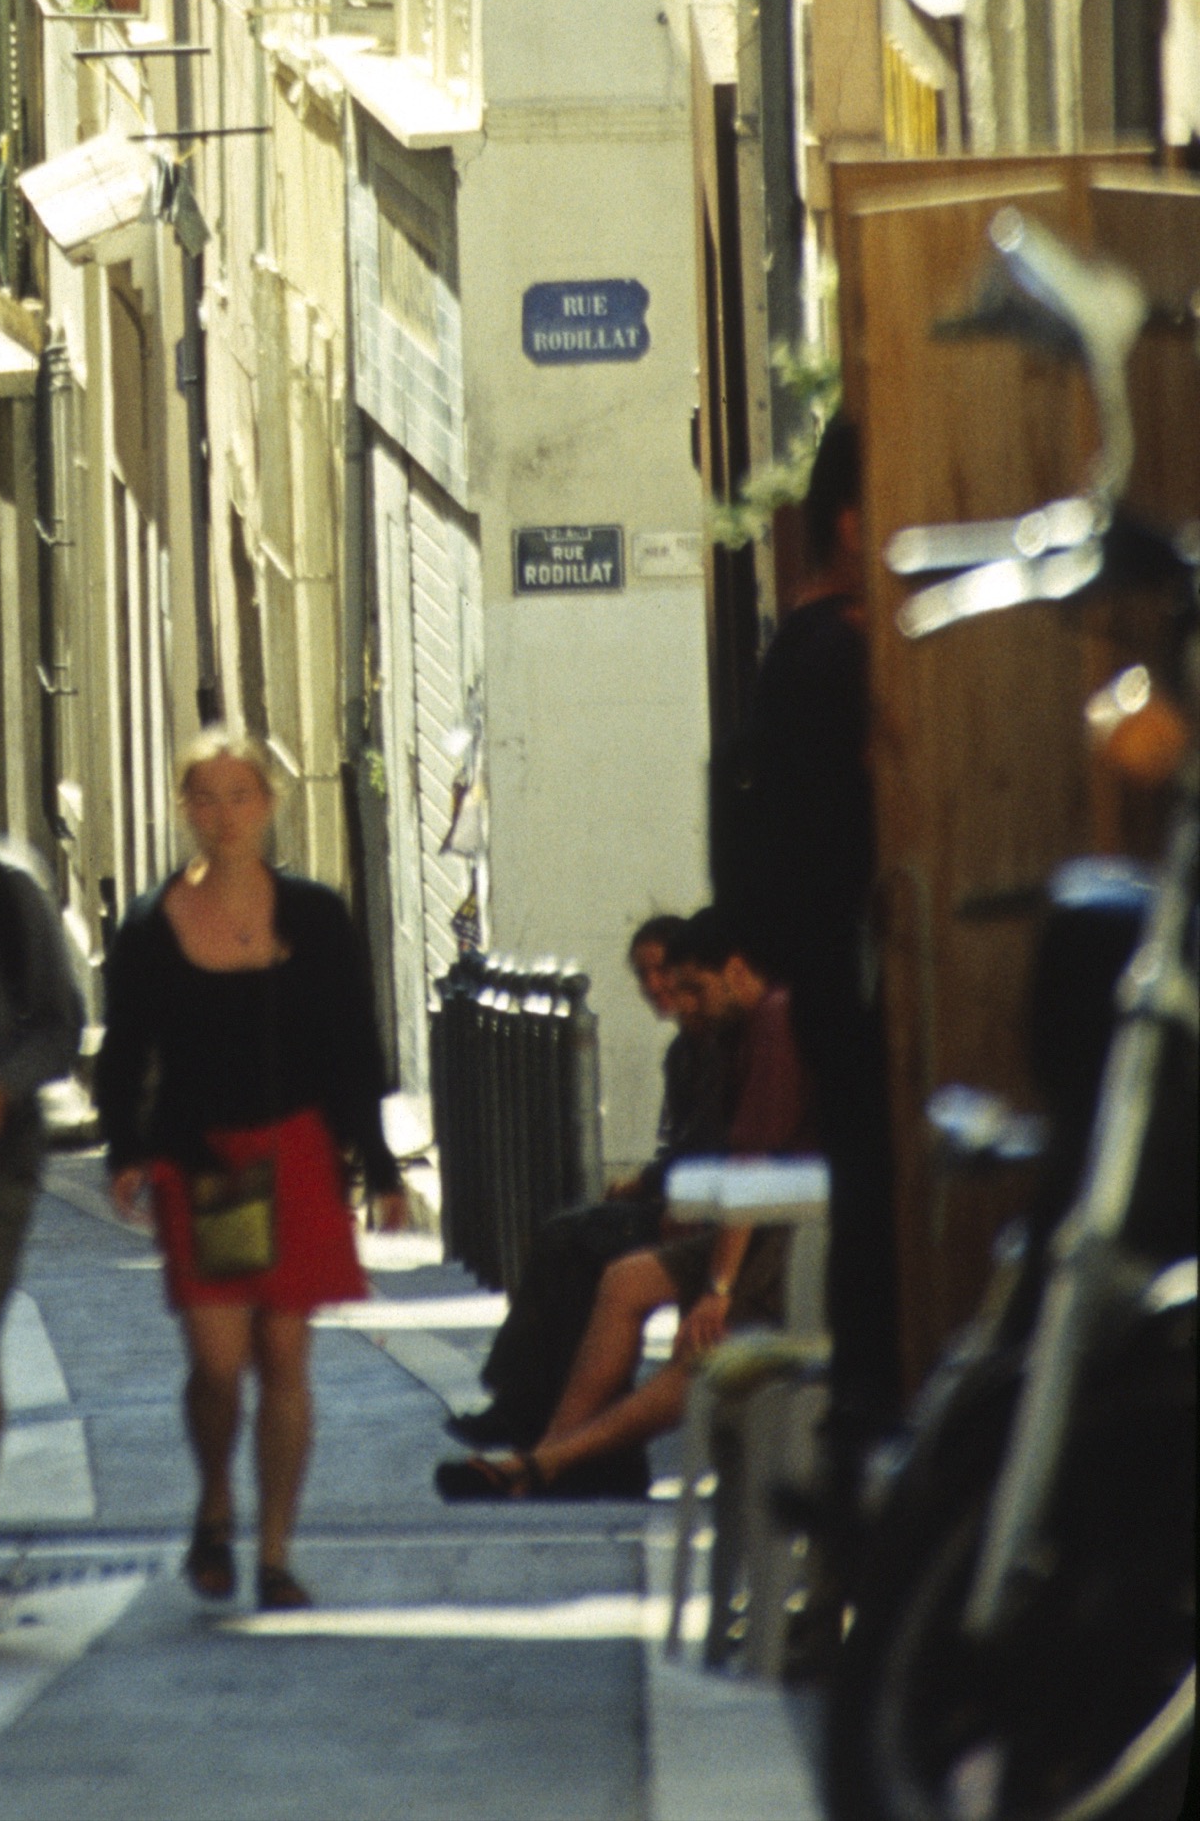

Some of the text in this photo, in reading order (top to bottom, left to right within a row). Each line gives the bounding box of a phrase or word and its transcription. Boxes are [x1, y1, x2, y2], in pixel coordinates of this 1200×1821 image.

[563, 293, 608, 314] RUE
[532, 325, 640, 350] RODILLAT
[551, 545, 585, 562] RUE
[523, 563, 613, 586] RODILLAT
